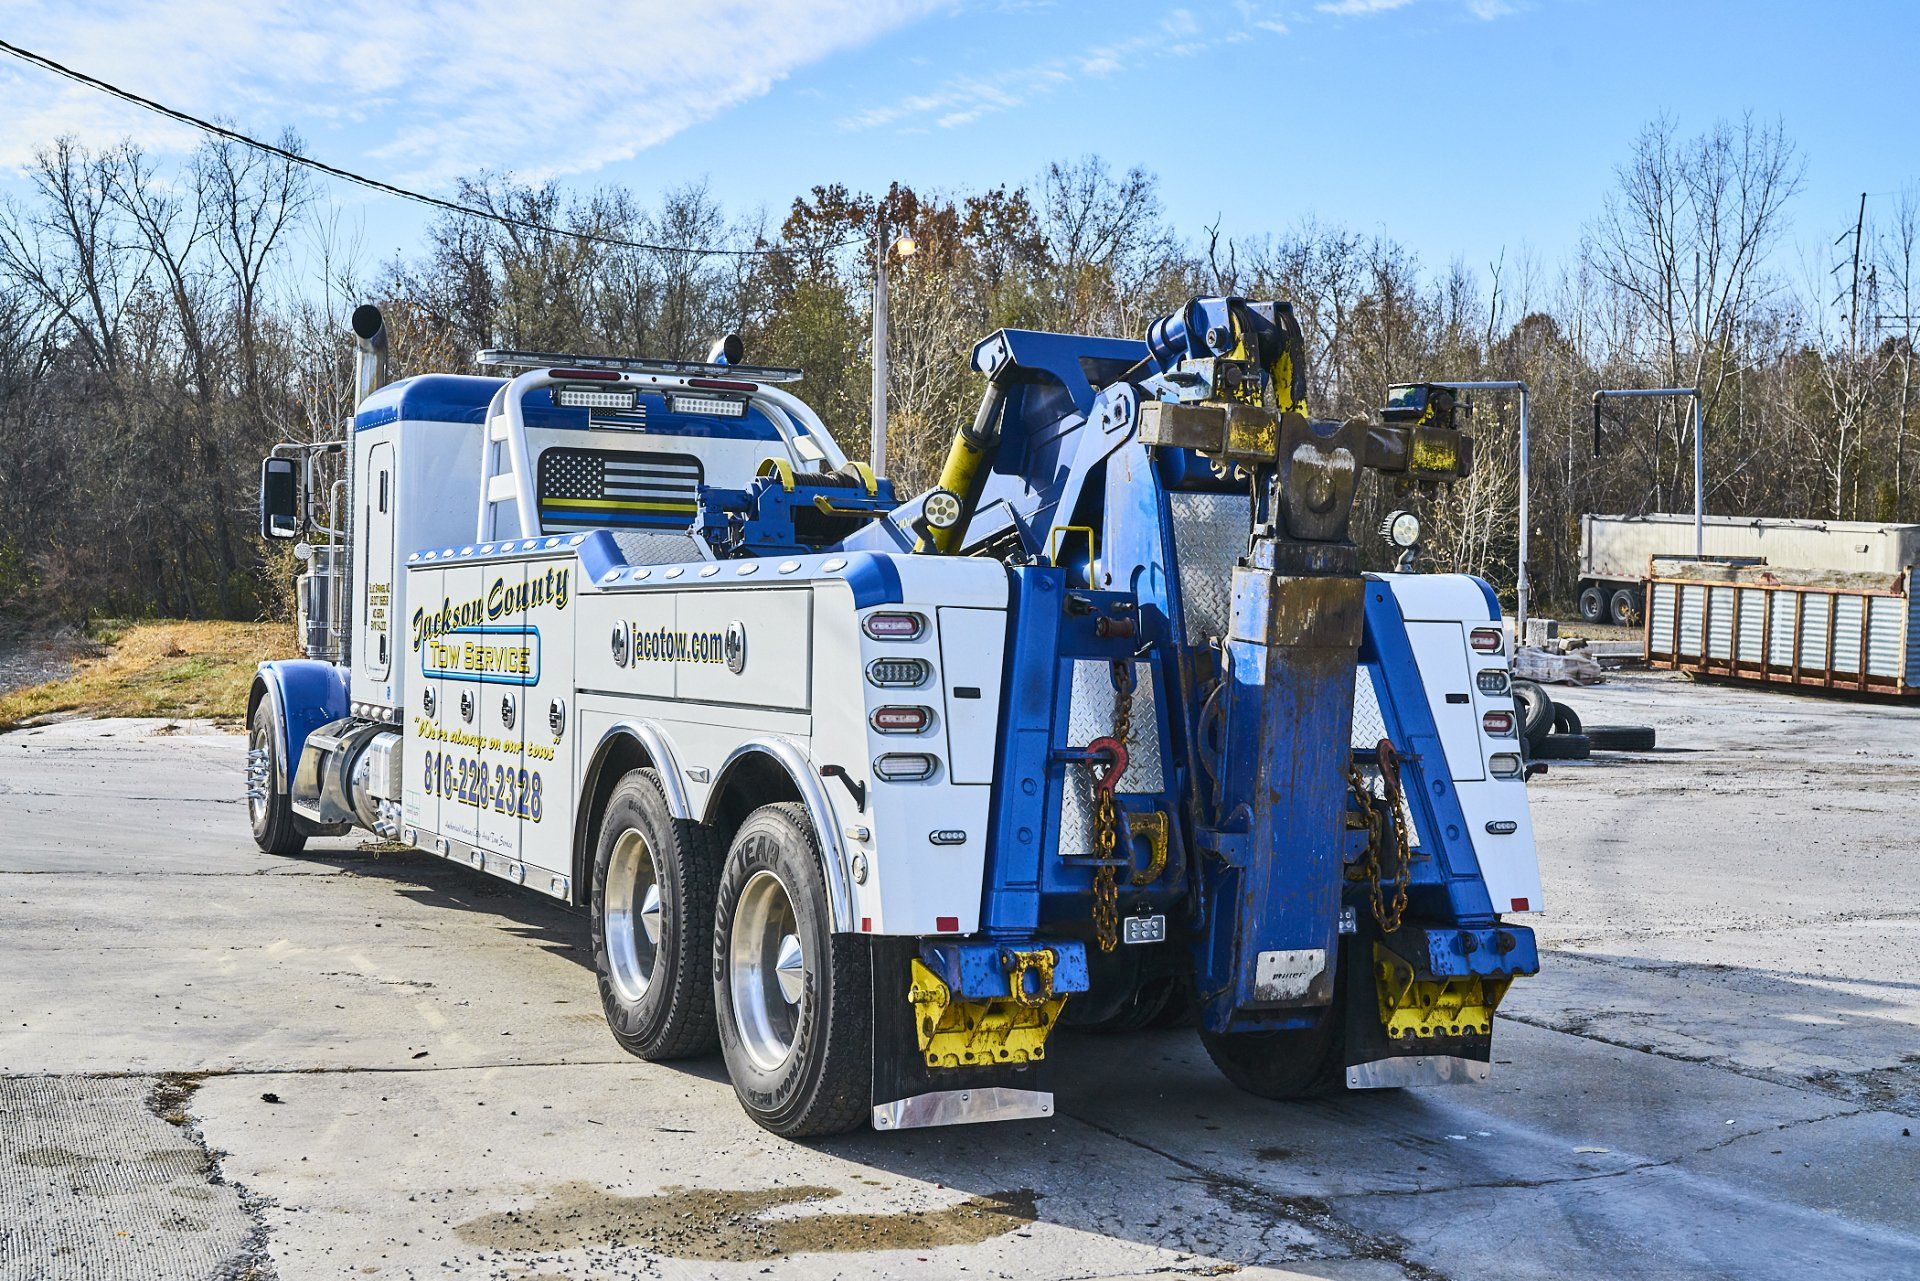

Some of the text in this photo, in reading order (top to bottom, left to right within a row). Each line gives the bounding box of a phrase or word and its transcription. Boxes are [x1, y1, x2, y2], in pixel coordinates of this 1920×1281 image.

[412, 568, 569, 652] Jackson County
[631, 622, 724, 669] jacotow.com
[450, 727, 487, 754] always
[488, 737, 501, 751] on
[503, 739, 524, 755] our
[424, 750, 542, 823] 816-228-2328
[776, 969, 814, 1102] MARATHON
